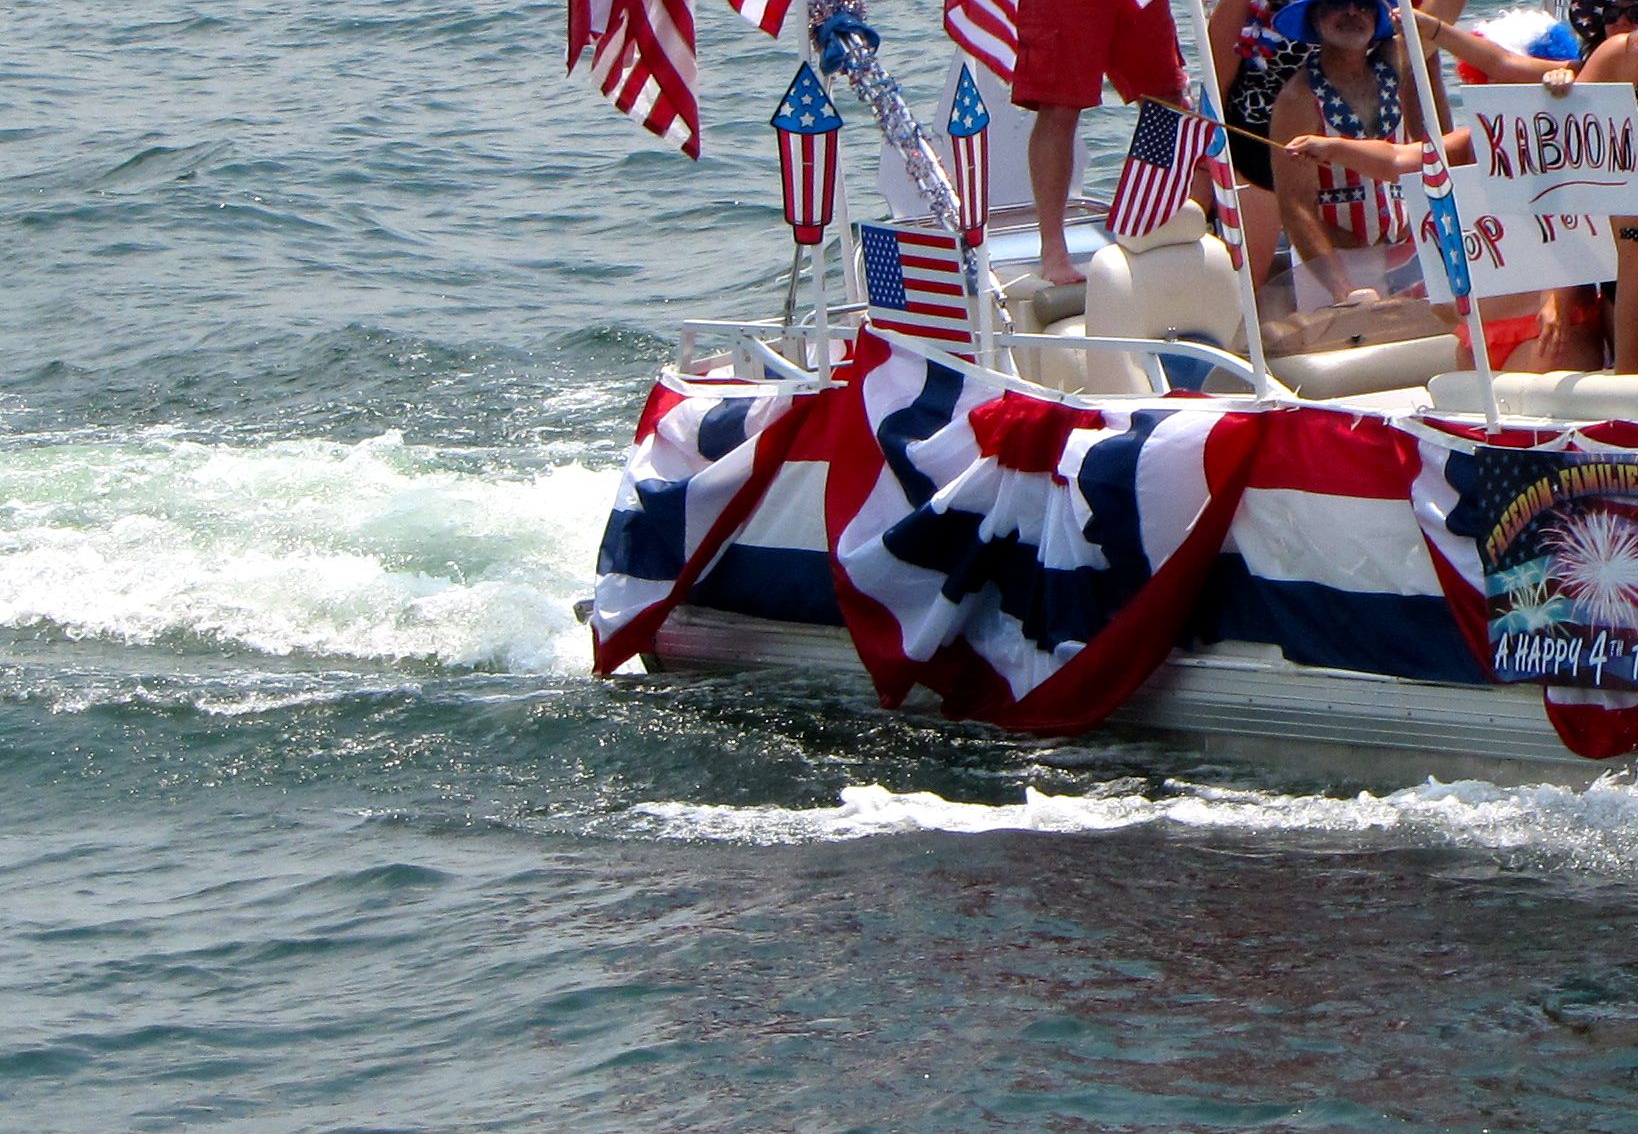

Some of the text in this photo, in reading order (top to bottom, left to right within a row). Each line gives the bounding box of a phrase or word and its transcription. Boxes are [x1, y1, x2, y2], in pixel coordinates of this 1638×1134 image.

[1476, 112, 1637, 179] KABOOM
[1486, 476, 1556, 566] FREEDOM
[1494, 632, 1509, 670] A
[1514, 633, 1583, 677] HAPPY
